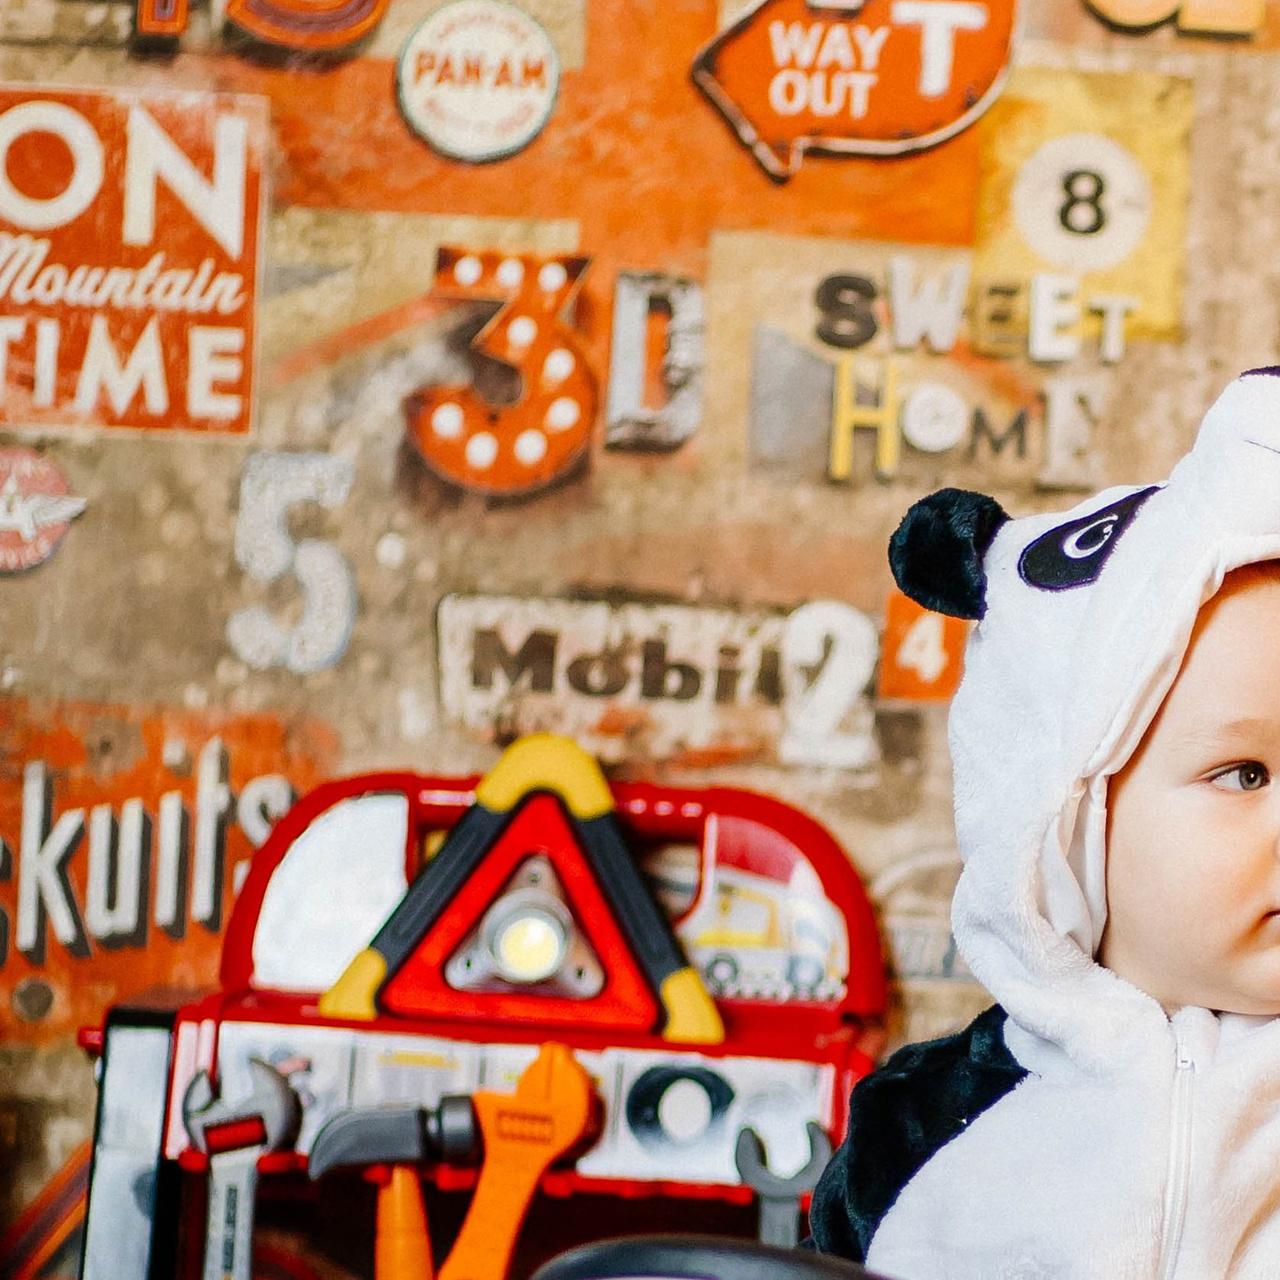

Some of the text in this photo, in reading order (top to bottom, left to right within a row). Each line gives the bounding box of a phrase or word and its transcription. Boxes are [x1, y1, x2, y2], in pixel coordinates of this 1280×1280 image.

[768, 19, 892, 74] WAY
[767, 66, 880, 120] OUT
[1057, 169, 1110, 237] 8
[814, 253, 1140, 366] SWEET
[828, 350, 1102, 490] HOME
[225, 450, 357, 674] 5
[470, 628, 785, 706] Mobil
